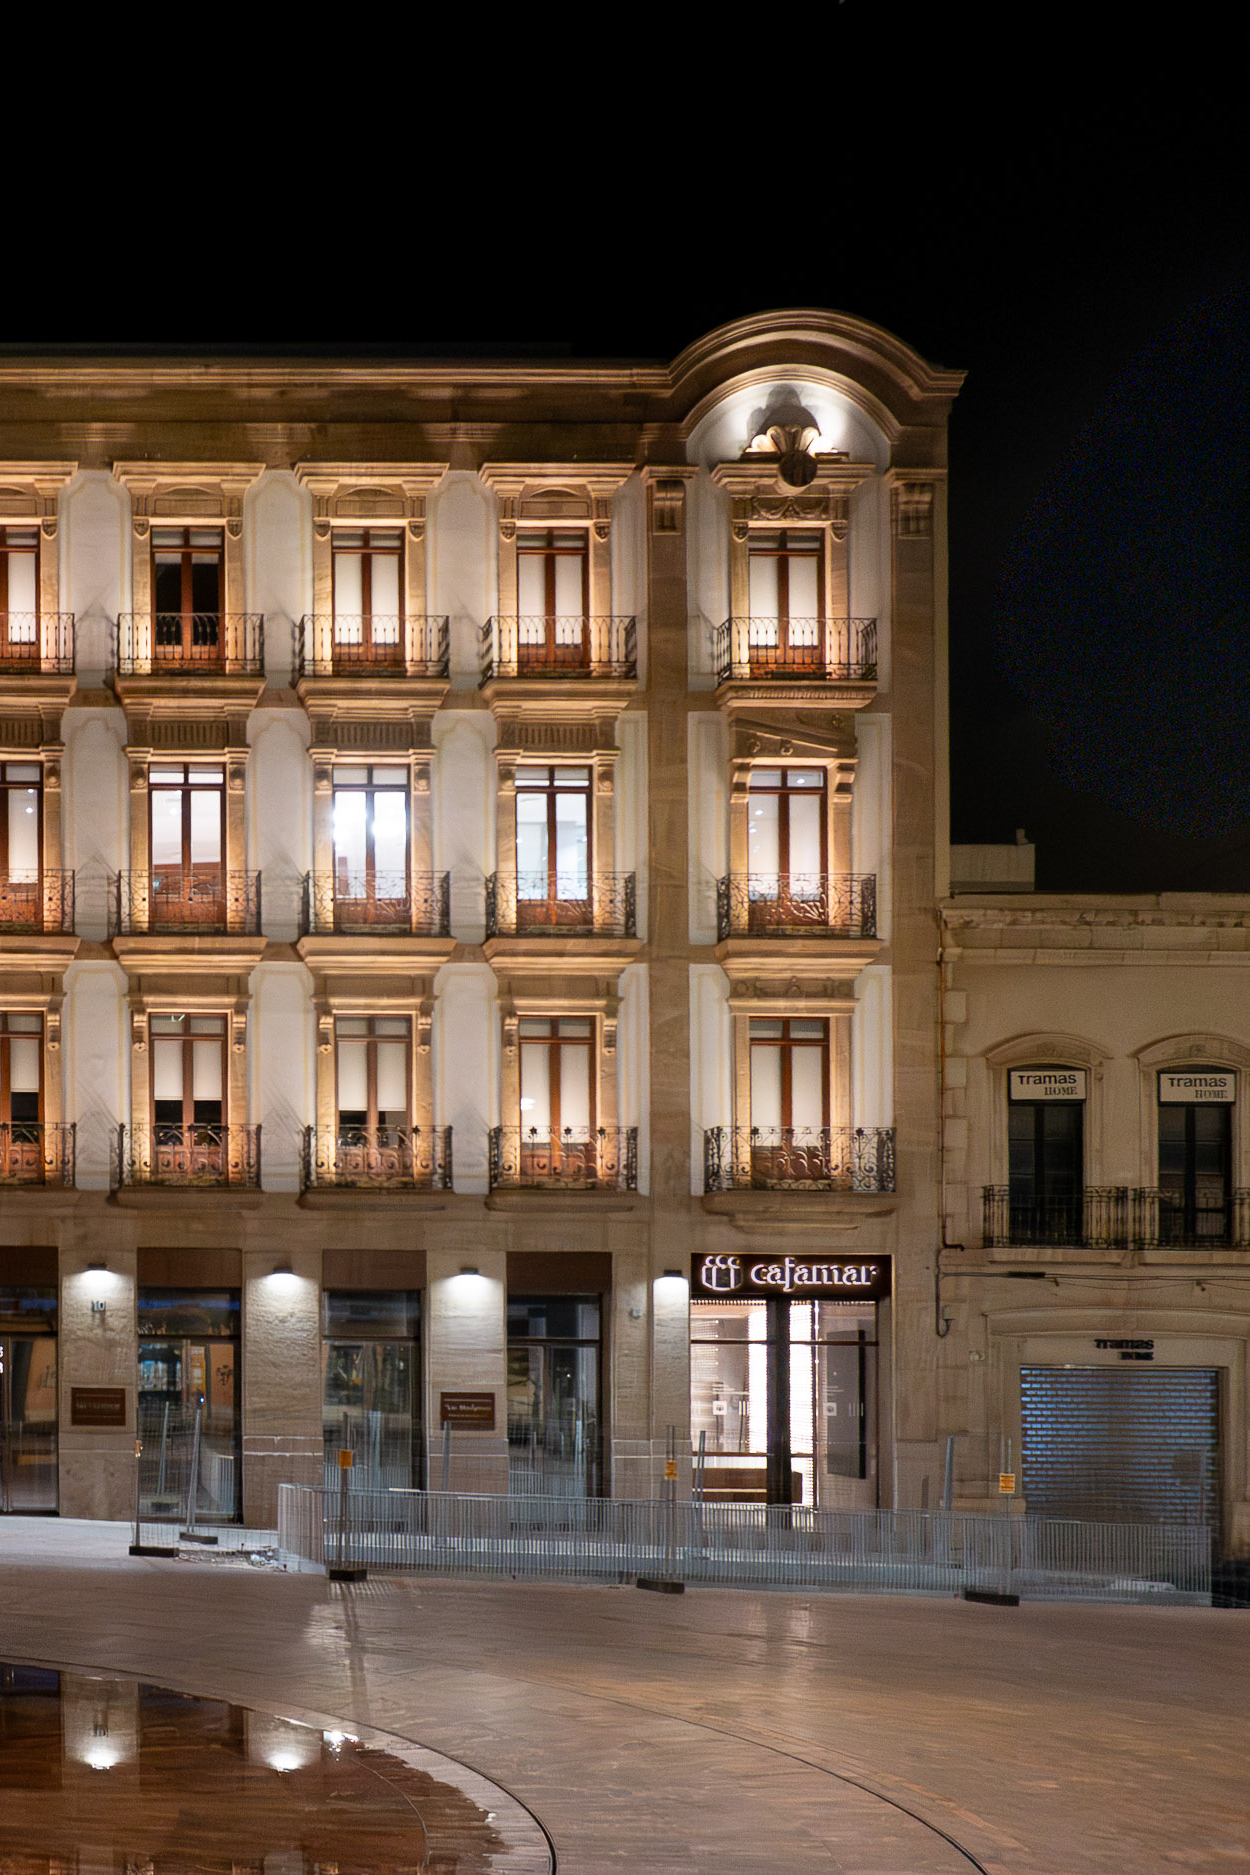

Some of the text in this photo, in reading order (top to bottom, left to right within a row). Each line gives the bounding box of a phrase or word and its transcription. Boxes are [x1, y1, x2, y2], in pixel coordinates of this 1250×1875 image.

[1044, 1086, 1078, 1096] HOME
[751, 1256, 878, 1292] cajamar
[91, 1300, 106, 1312] 10
